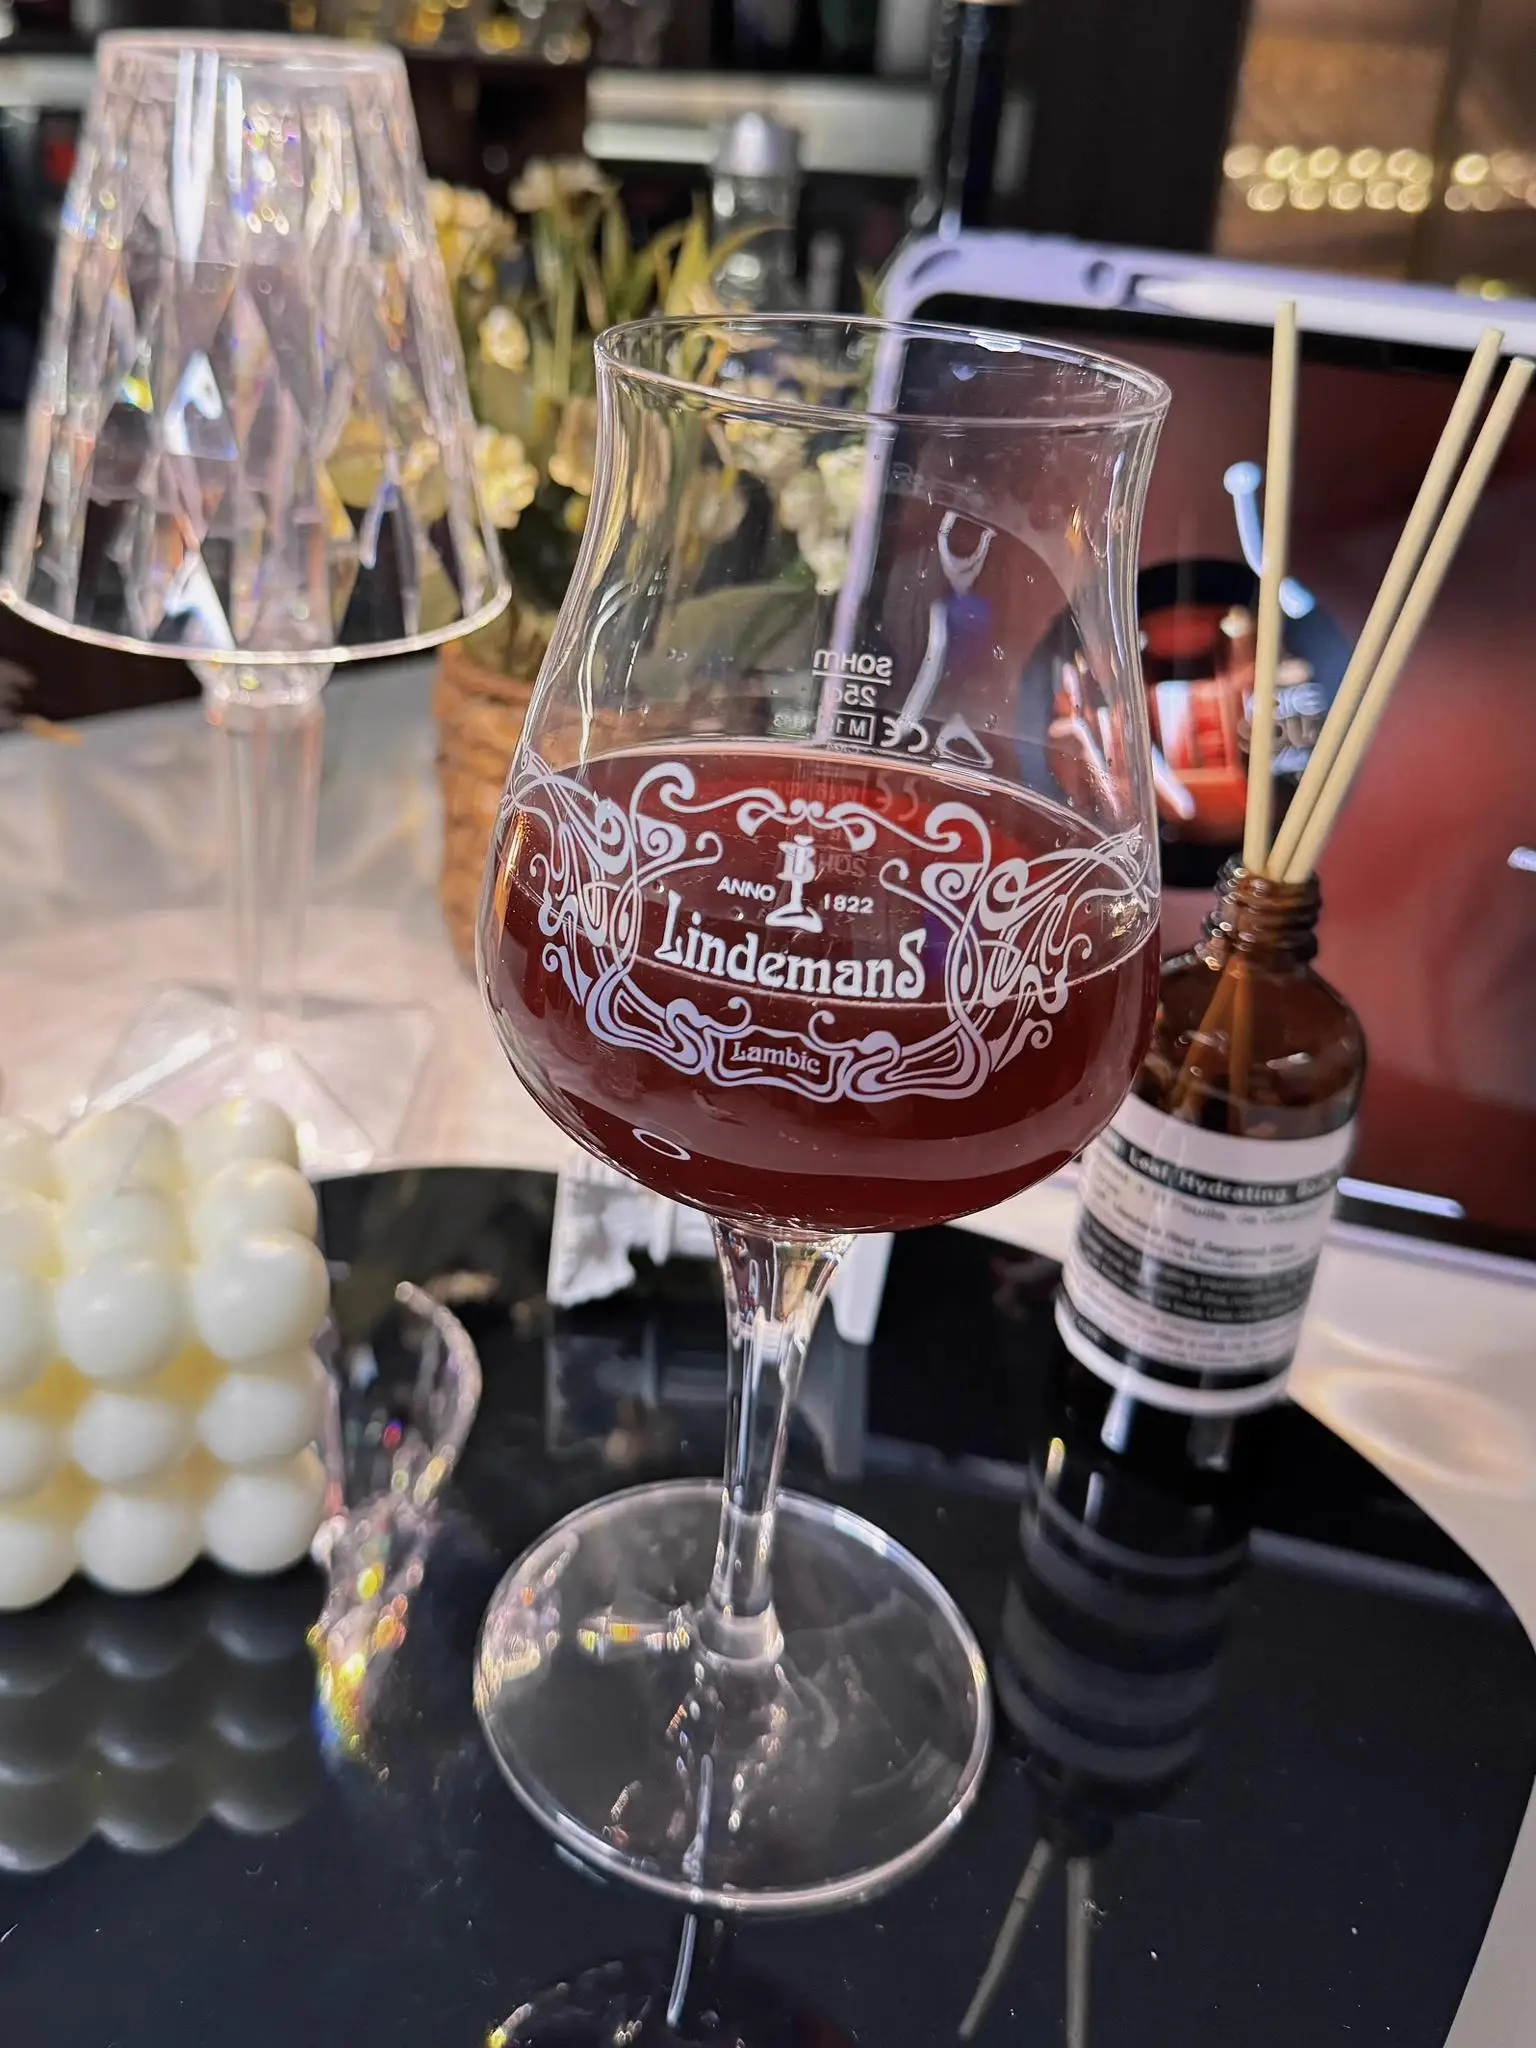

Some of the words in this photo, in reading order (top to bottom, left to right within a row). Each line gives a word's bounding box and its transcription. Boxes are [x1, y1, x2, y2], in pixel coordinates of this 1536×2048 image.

[717, 876, 777, 902] ANNO
[823, 893, 875, 915] 1822
[730, 1041, 821, 1076] Lambic
[1129, 1147, 1170, 1179] Leaf
[1179, 1170, 1289, 1204] Hydrating
